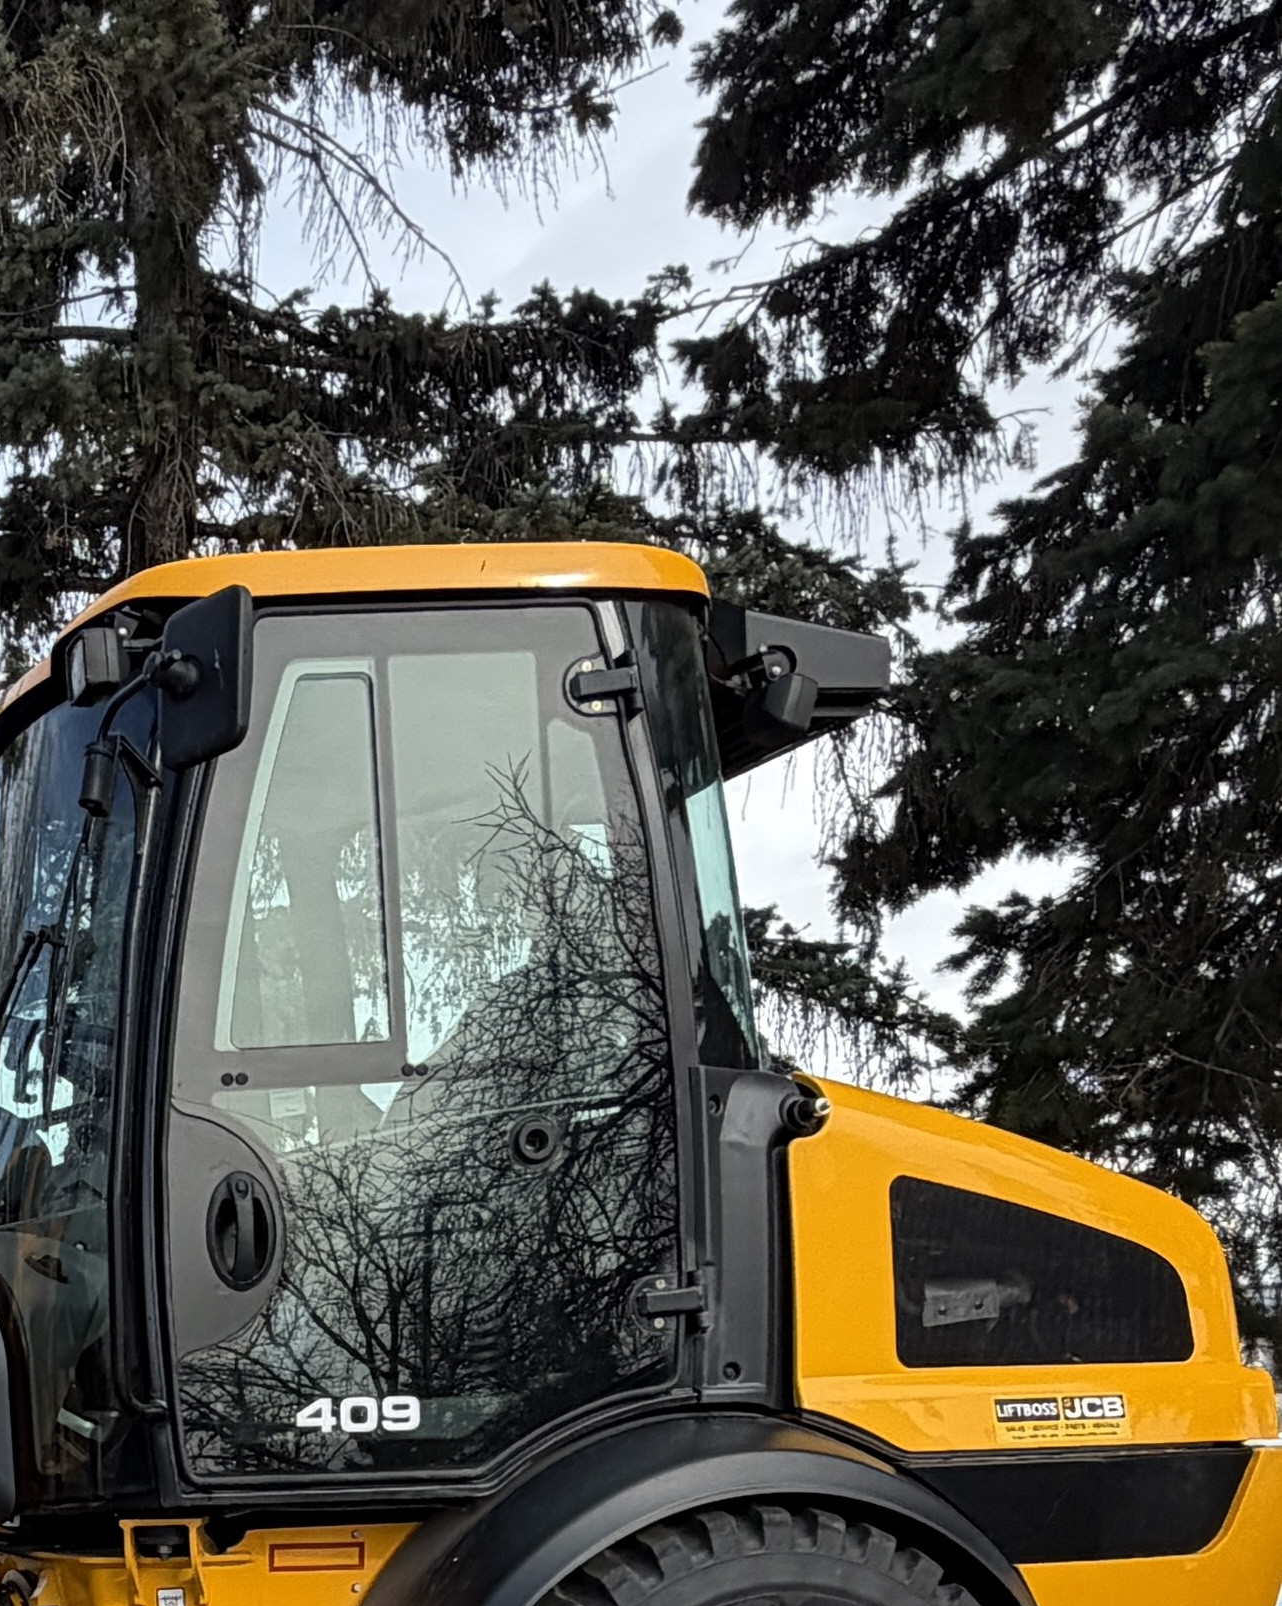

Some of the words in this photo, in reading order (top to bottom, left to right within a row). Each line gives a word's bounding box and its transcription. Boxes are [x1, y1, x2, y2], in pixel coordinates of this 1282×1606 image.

[295, 1395, 420, 1433] 409
[995, 1402, 1058, 1418] LIFTBOSS
[1064, 1396, 1124, 1419] JCB
